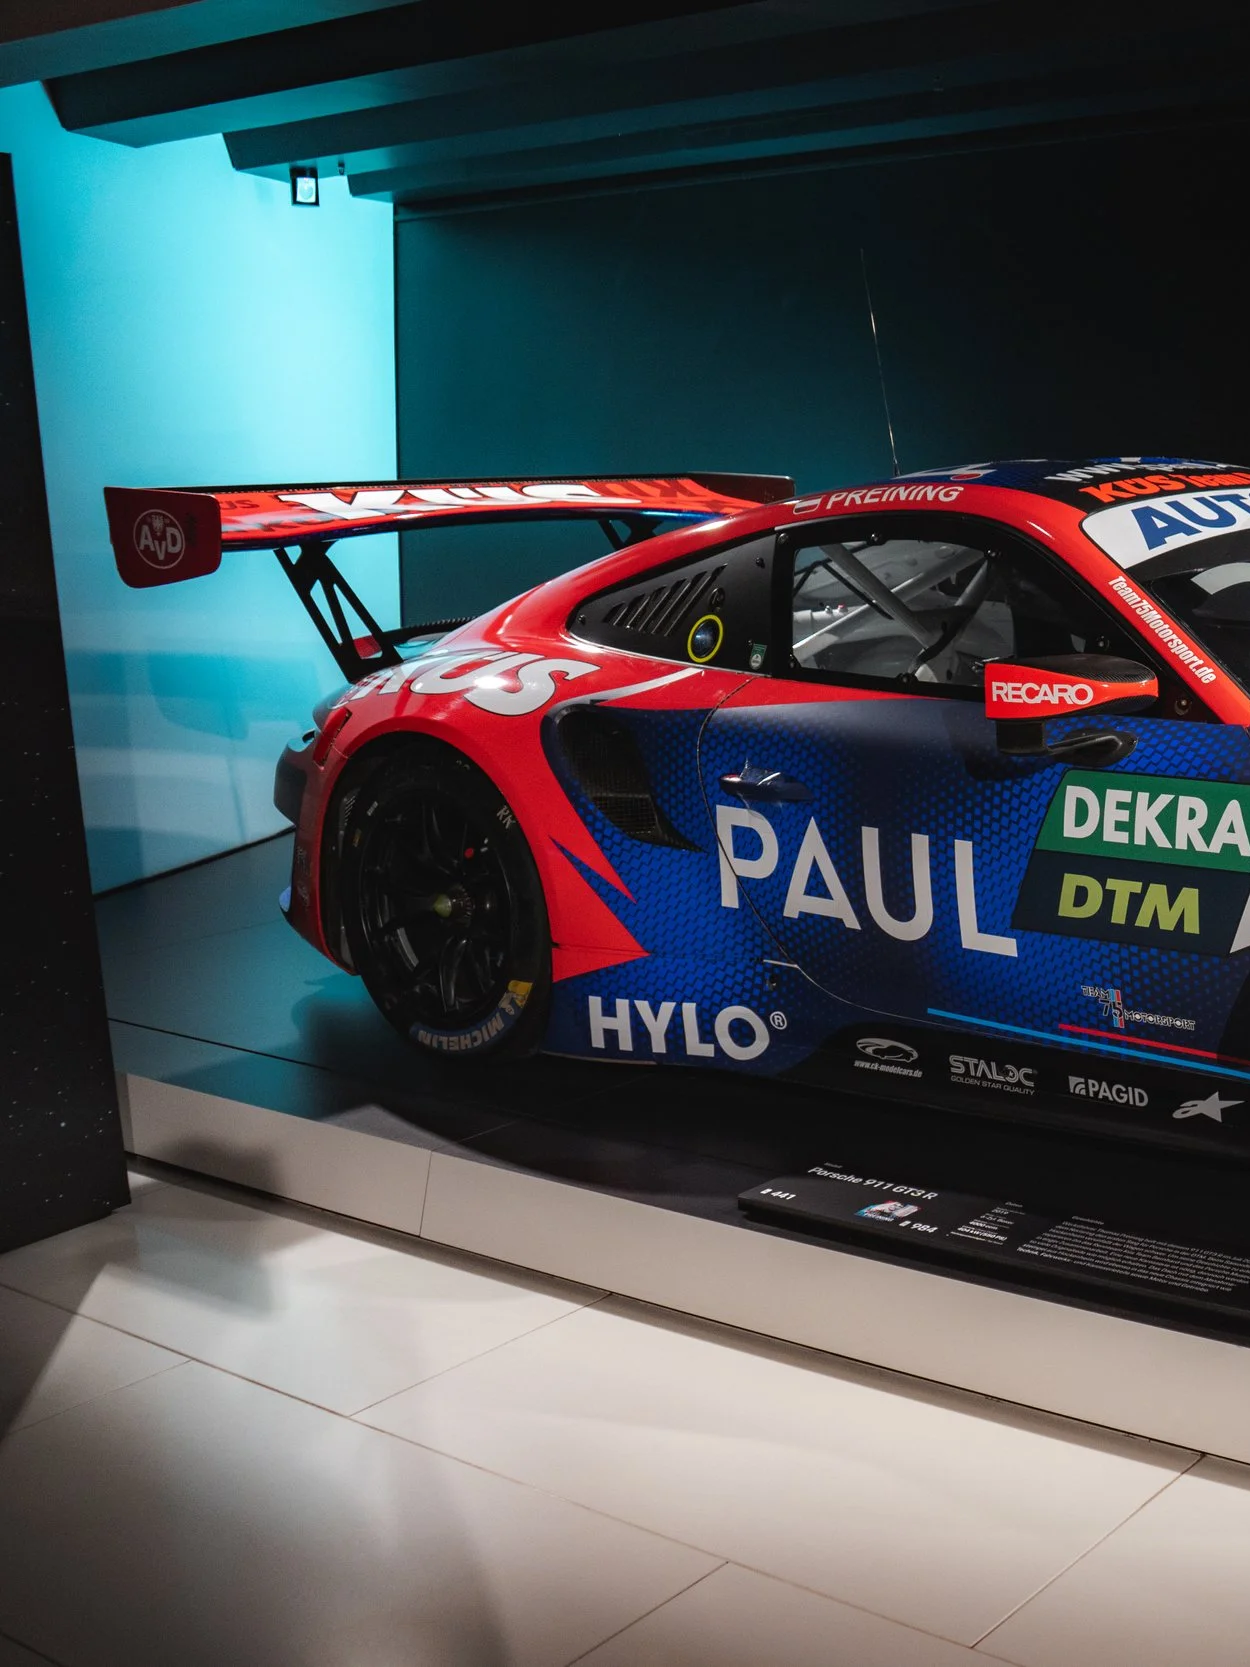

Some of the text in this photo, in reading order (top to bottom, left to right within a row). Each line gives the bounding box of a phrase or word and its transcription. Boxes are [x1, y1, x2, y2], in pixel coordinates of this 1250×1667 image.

[826, 486, 964, 510] PREINING
[1107, 575, 1217, 685] Team75Motorsport.de
[992, 681, 1094, 705] RECARO
[716, 804, 1018, 958] PAUL
[1058, 873, 1200, 935] DTM
[416, 1011, 505, 1051] MICHELIN
[951, 1075, 1035, 1096] GOLDEN STAR QUALITY
[1088, 1078, 1149, 1108] PAGID
[770, 1190, 797, 1201] 441
[808, 1166, 939, 1200] Porsche 911 GT3 R
[910, 1222, 938, 1234] 984
